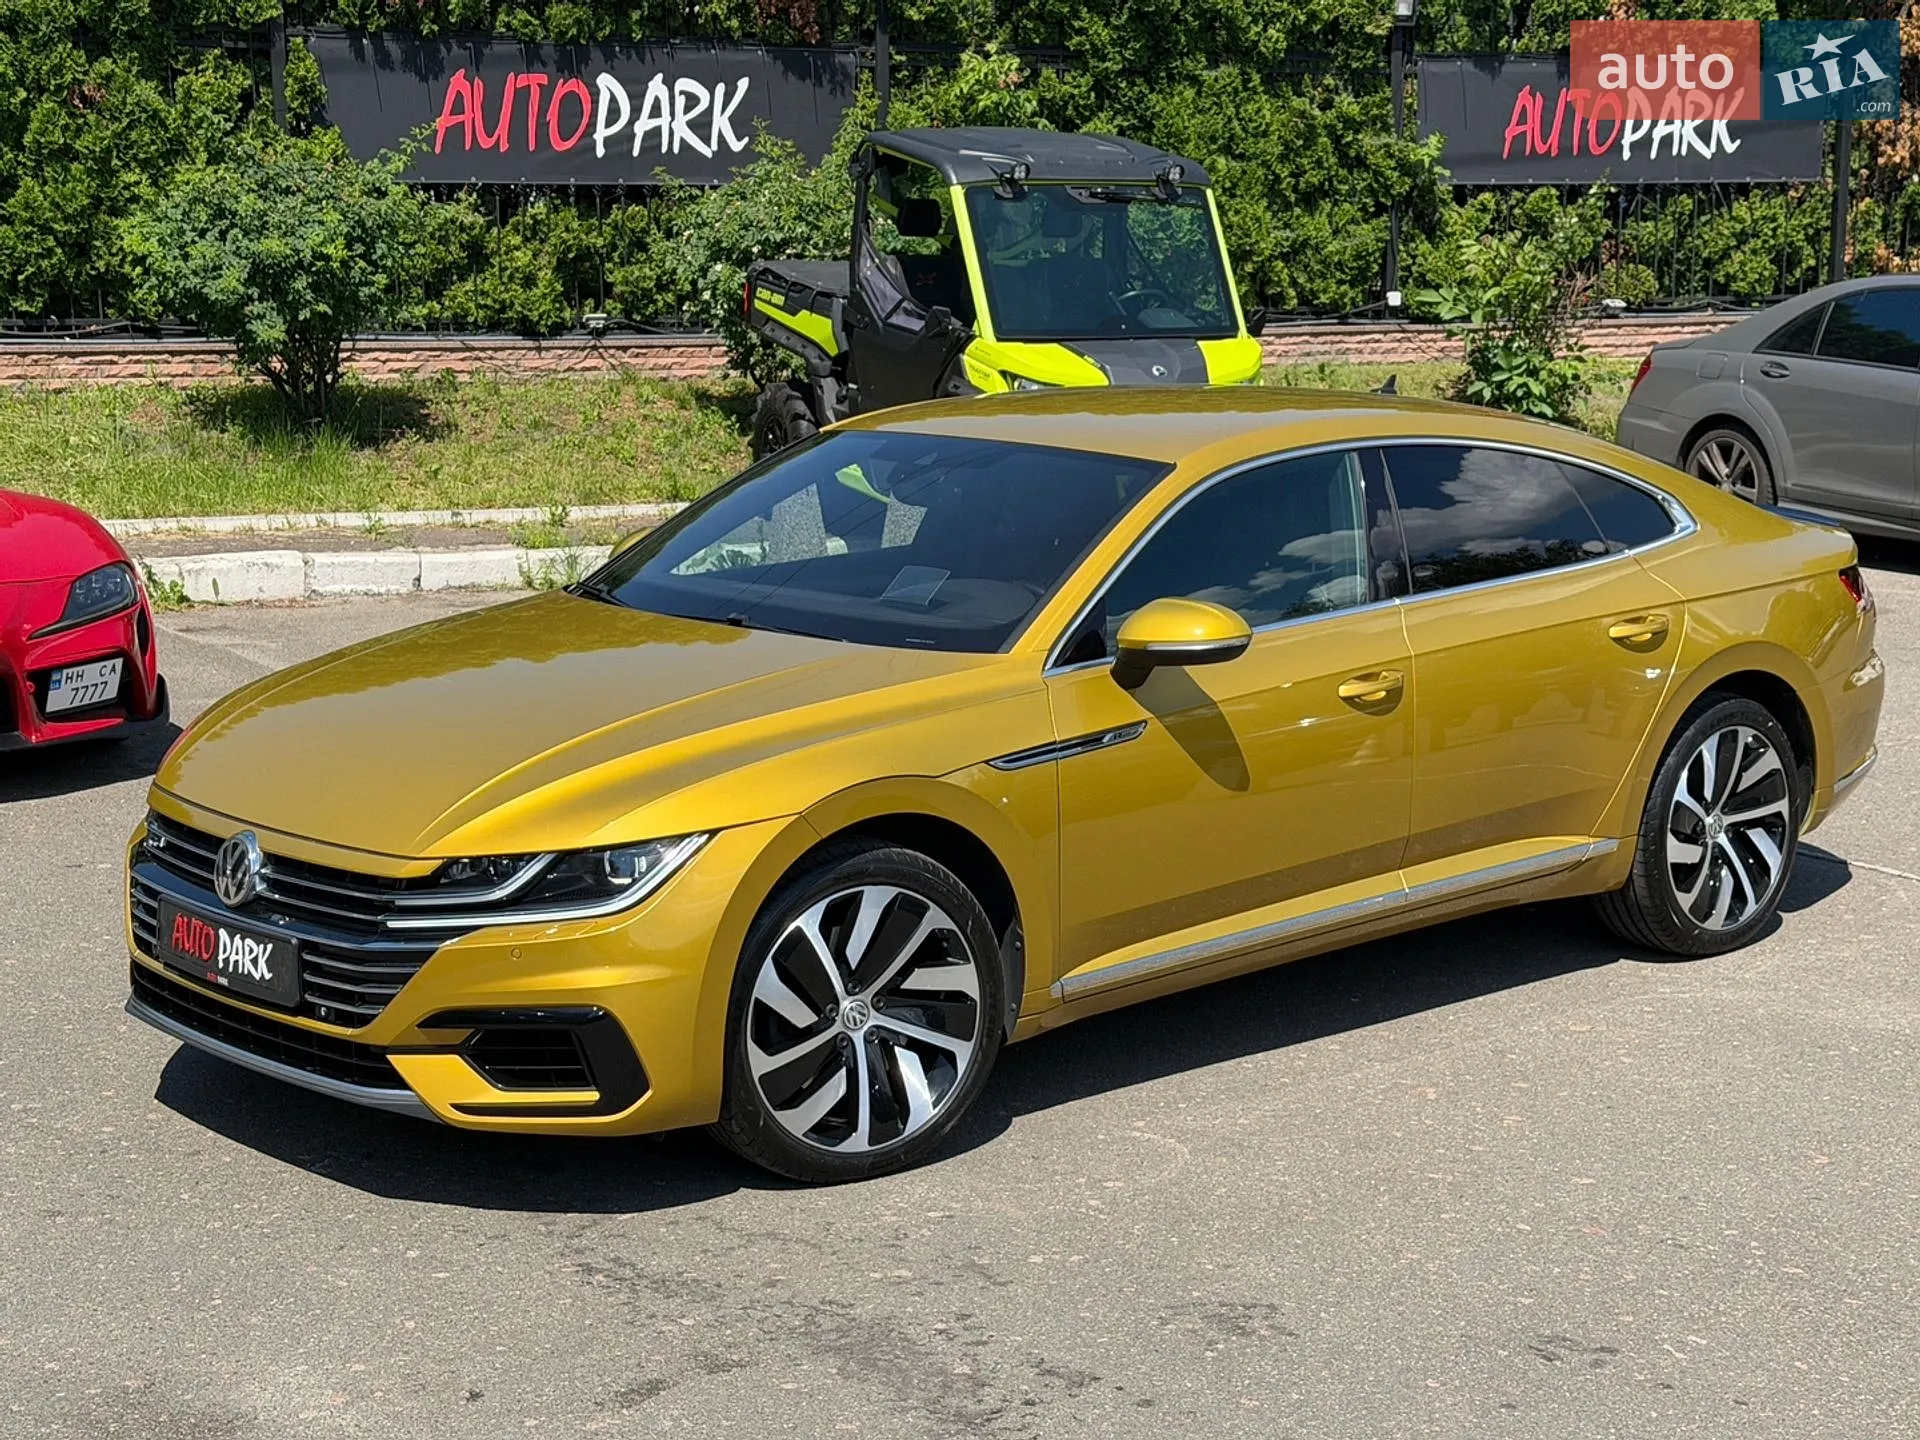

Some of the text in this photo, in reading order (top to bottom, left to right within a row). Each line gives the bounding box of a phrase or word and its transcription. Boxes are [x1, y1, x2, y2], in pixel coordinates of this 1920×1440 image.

[65, 669, 85, 685] HH
[98, 662, 117, 677] CA
[69, 681, 108, 706] 7777
